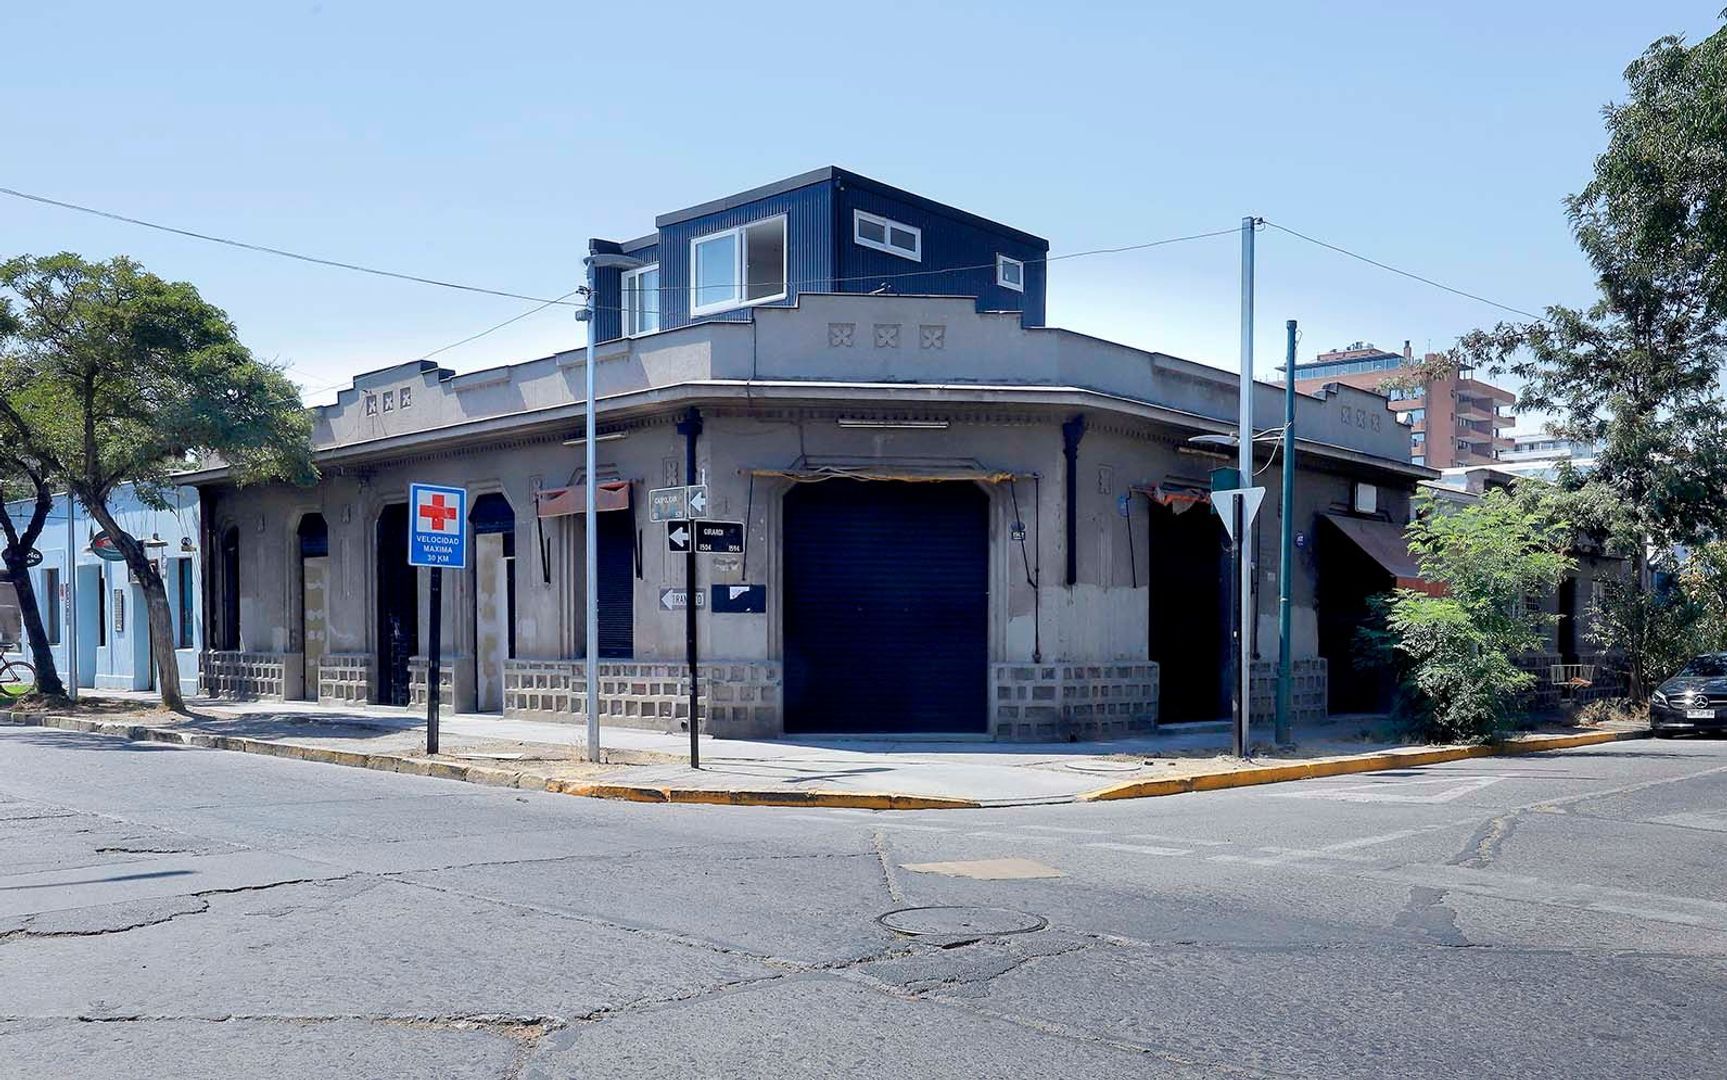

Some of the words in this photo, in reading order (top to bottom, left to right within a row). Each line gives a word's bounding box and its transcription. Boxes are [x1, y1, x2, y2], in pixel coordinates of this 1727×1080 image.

[703, 528, 724, 536] GIRARDI
[416, 535, 459, 545] VELOCIDAD
[423, 545, 453, 554] MAXIMA
[427, 554, 436, 562] 30
[437, 554, 449, 563] KM
